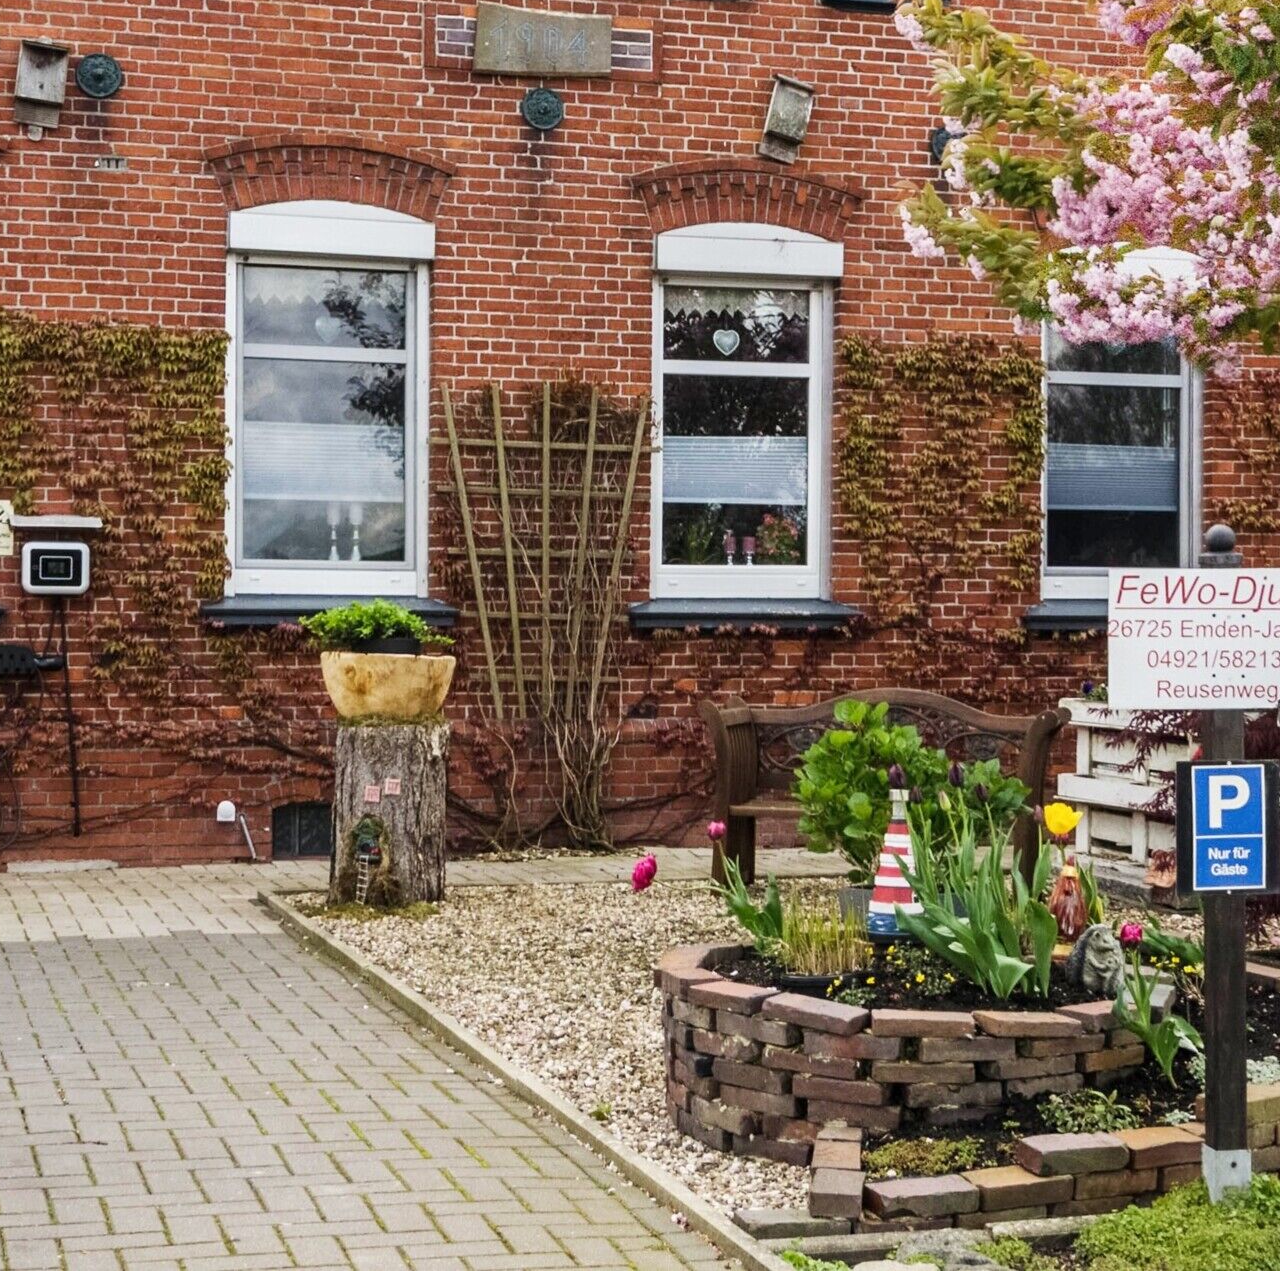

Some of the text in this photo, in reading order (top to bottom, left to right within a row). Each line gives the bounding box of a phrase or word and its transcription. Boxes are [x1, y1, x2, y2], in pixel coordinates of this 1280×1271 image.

[490, 17, 589, 66] 1904
[1108, 620, 1172, 638] 26725
[1156, 681, 1279, 702] Reusenweg
[1208, 775, 1251, 829] P
[1208, 847, 1251, 860] Nur für
[1211, 863, 1248, 876] Gäste
